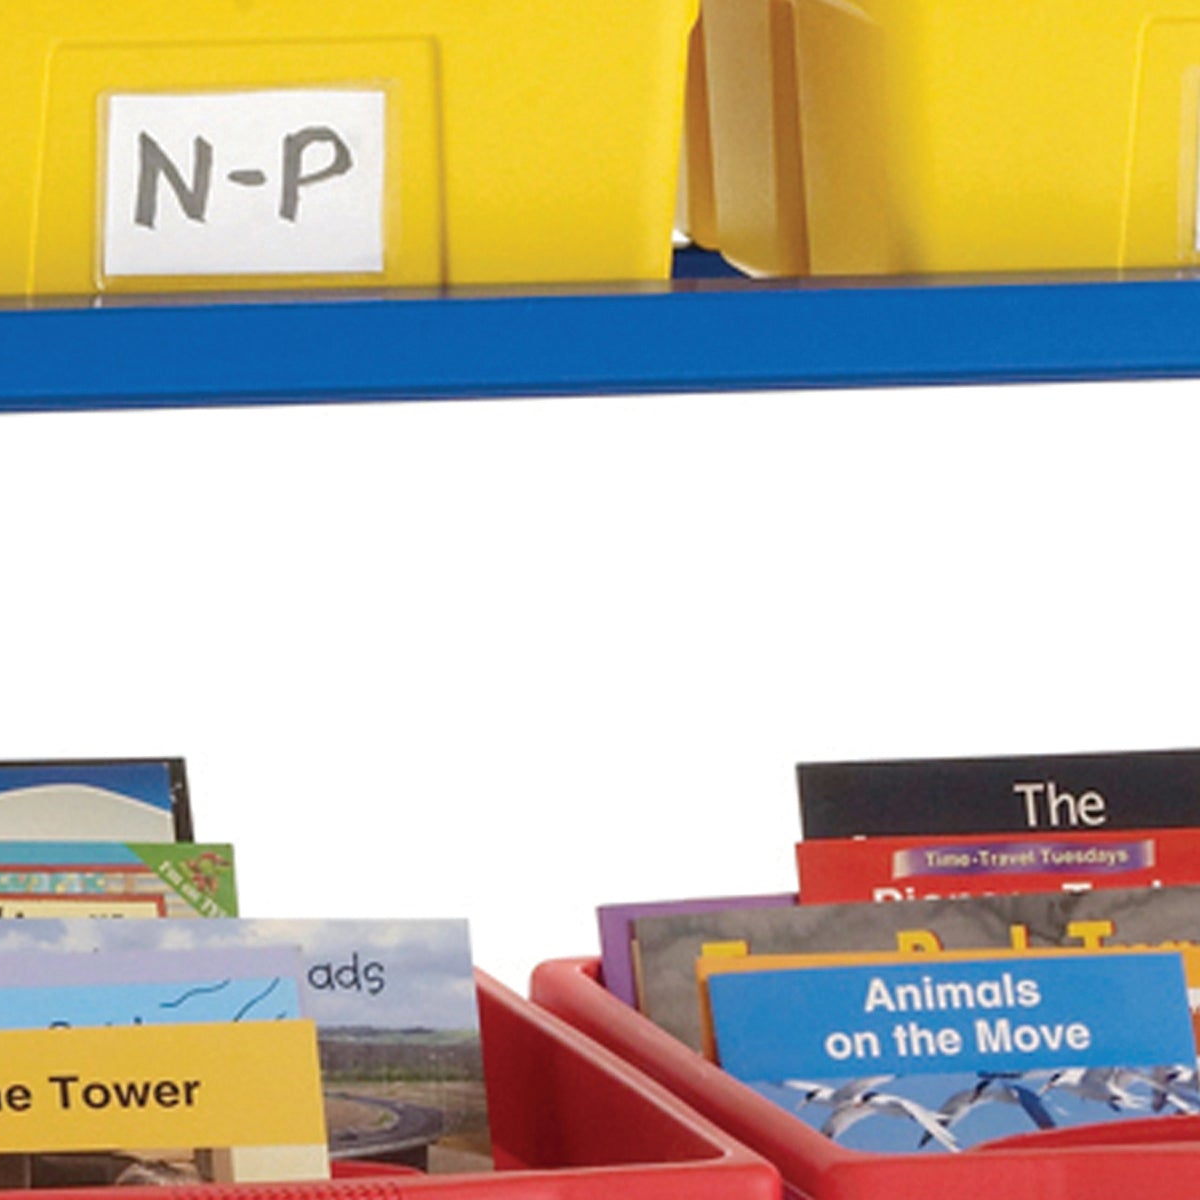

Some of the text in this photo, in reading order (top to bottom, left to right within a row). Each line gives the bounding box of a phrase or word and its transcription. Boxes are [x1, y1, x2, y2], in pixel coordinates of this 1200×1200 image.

[134, 127, 353, 230] N-P
[1013, 782, 1106, 827] The
[1040, 847, 1130, 867] Tuesdays
[864, 972, 1042, 1013] Animals
[824, 1018, 1091, 1060] on the Move
[48, 1075, 200, 1110] Tower
